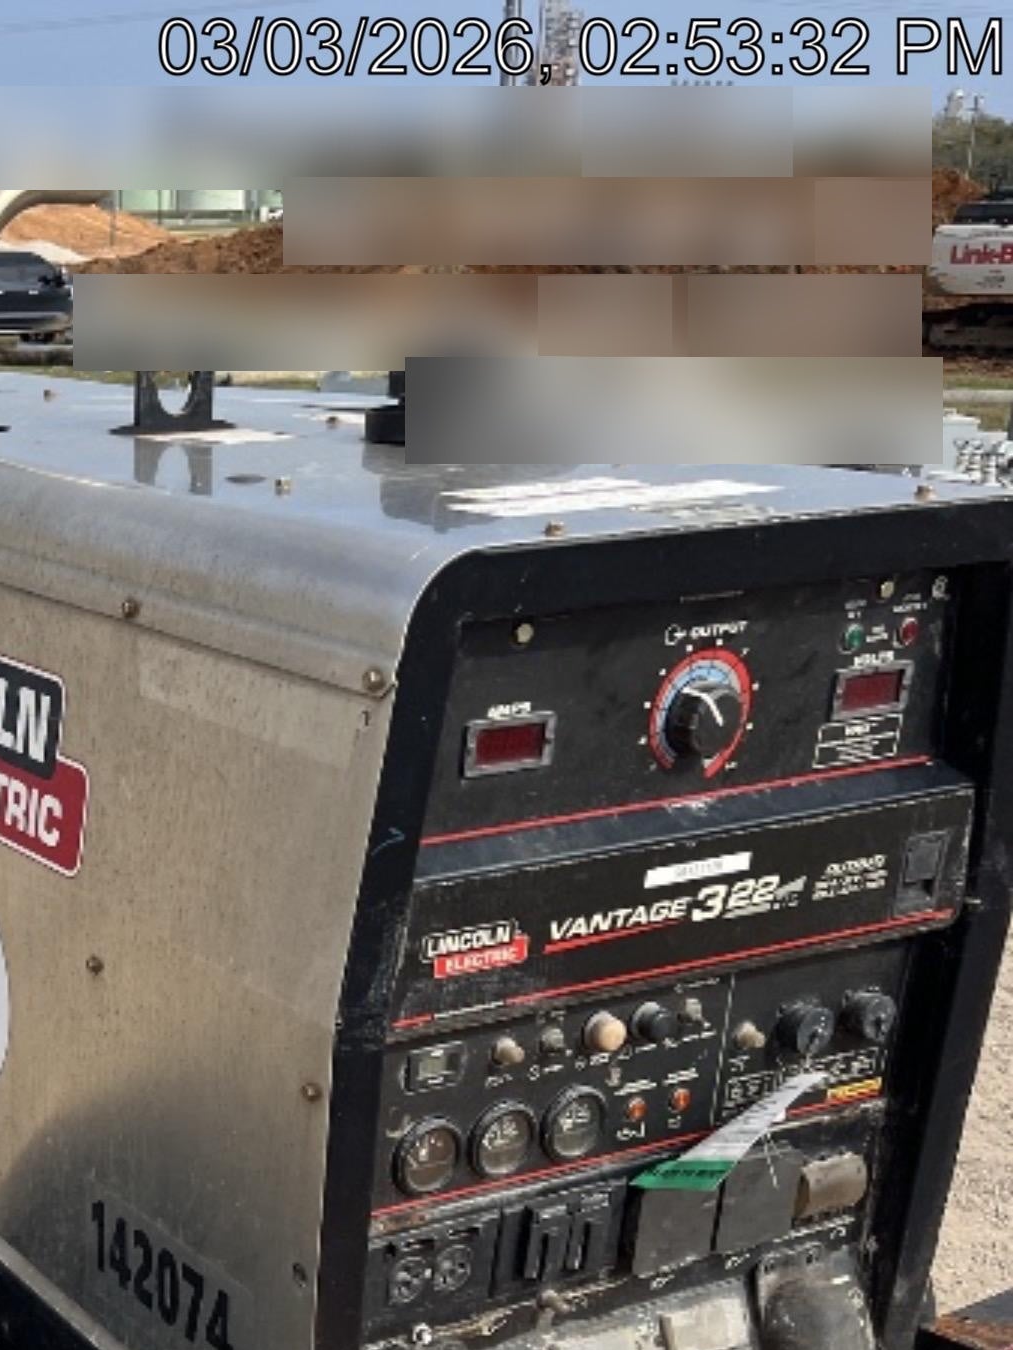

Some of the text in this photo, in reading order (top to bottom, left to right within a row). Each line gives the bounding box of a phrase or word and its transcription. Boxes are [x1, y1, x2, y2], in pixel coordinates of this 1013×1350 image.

[549, 896, 692, 941] VANTAGE
[692, 875, 781, 922] 322
[426, 922, 512, 958] LINCOLN
[444, 945, 520, 975] ELECTRIC
